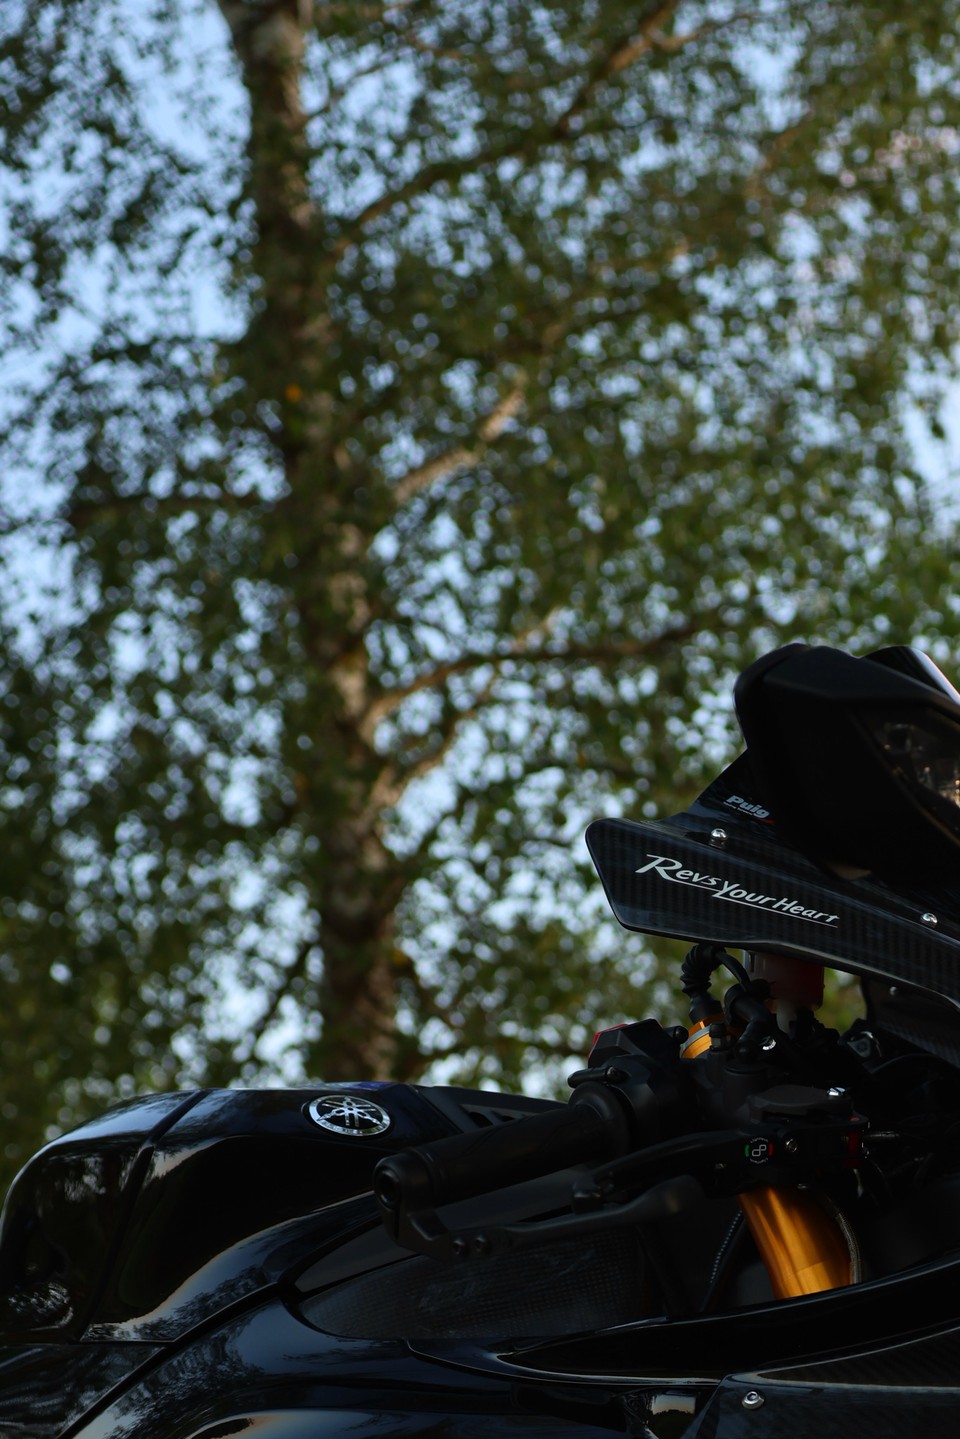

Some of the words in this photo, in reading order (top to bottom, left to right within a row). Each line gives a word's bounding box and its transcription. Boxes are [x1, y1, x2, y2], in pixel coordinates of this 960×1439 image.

[725, 794, 771, 819] Puig
[634, 853, 722, 888] Revs
[711, 880, 777, 906] Your
[772, 897, 840, 924] Heart
